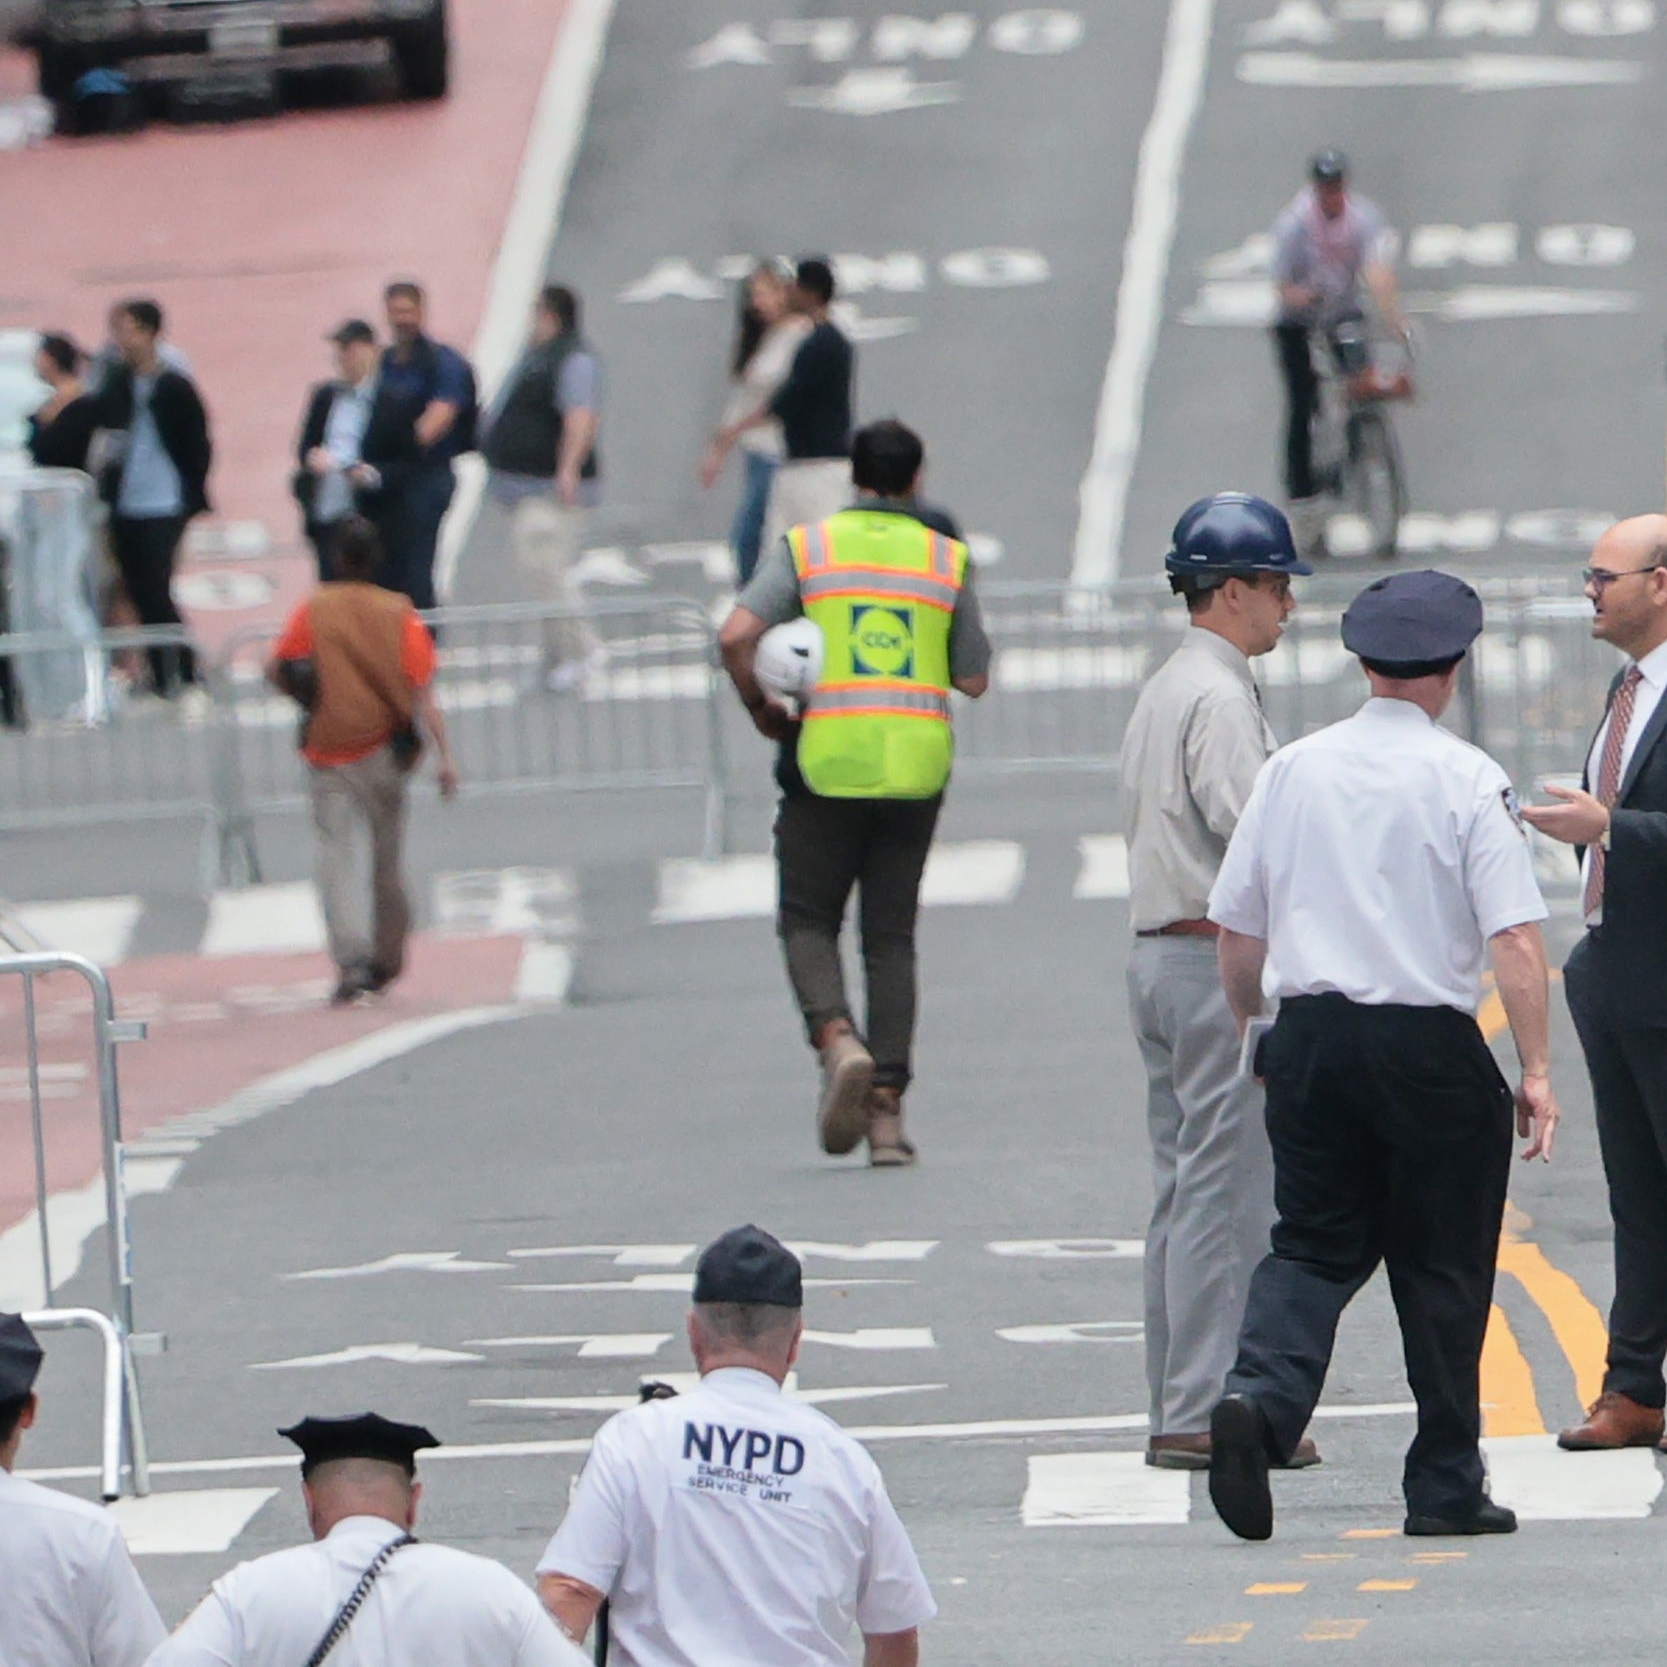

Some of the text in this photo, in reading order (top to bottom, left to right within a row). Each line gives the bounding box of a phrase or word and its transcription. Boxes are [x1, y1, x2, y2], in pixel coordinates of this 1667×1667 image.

[682, 1420, 806, 1476] NYPD
[687, 1474, 793, 1503] SERVICE UNIT
[697, 1463, 785, 1488] EMERGENCY
